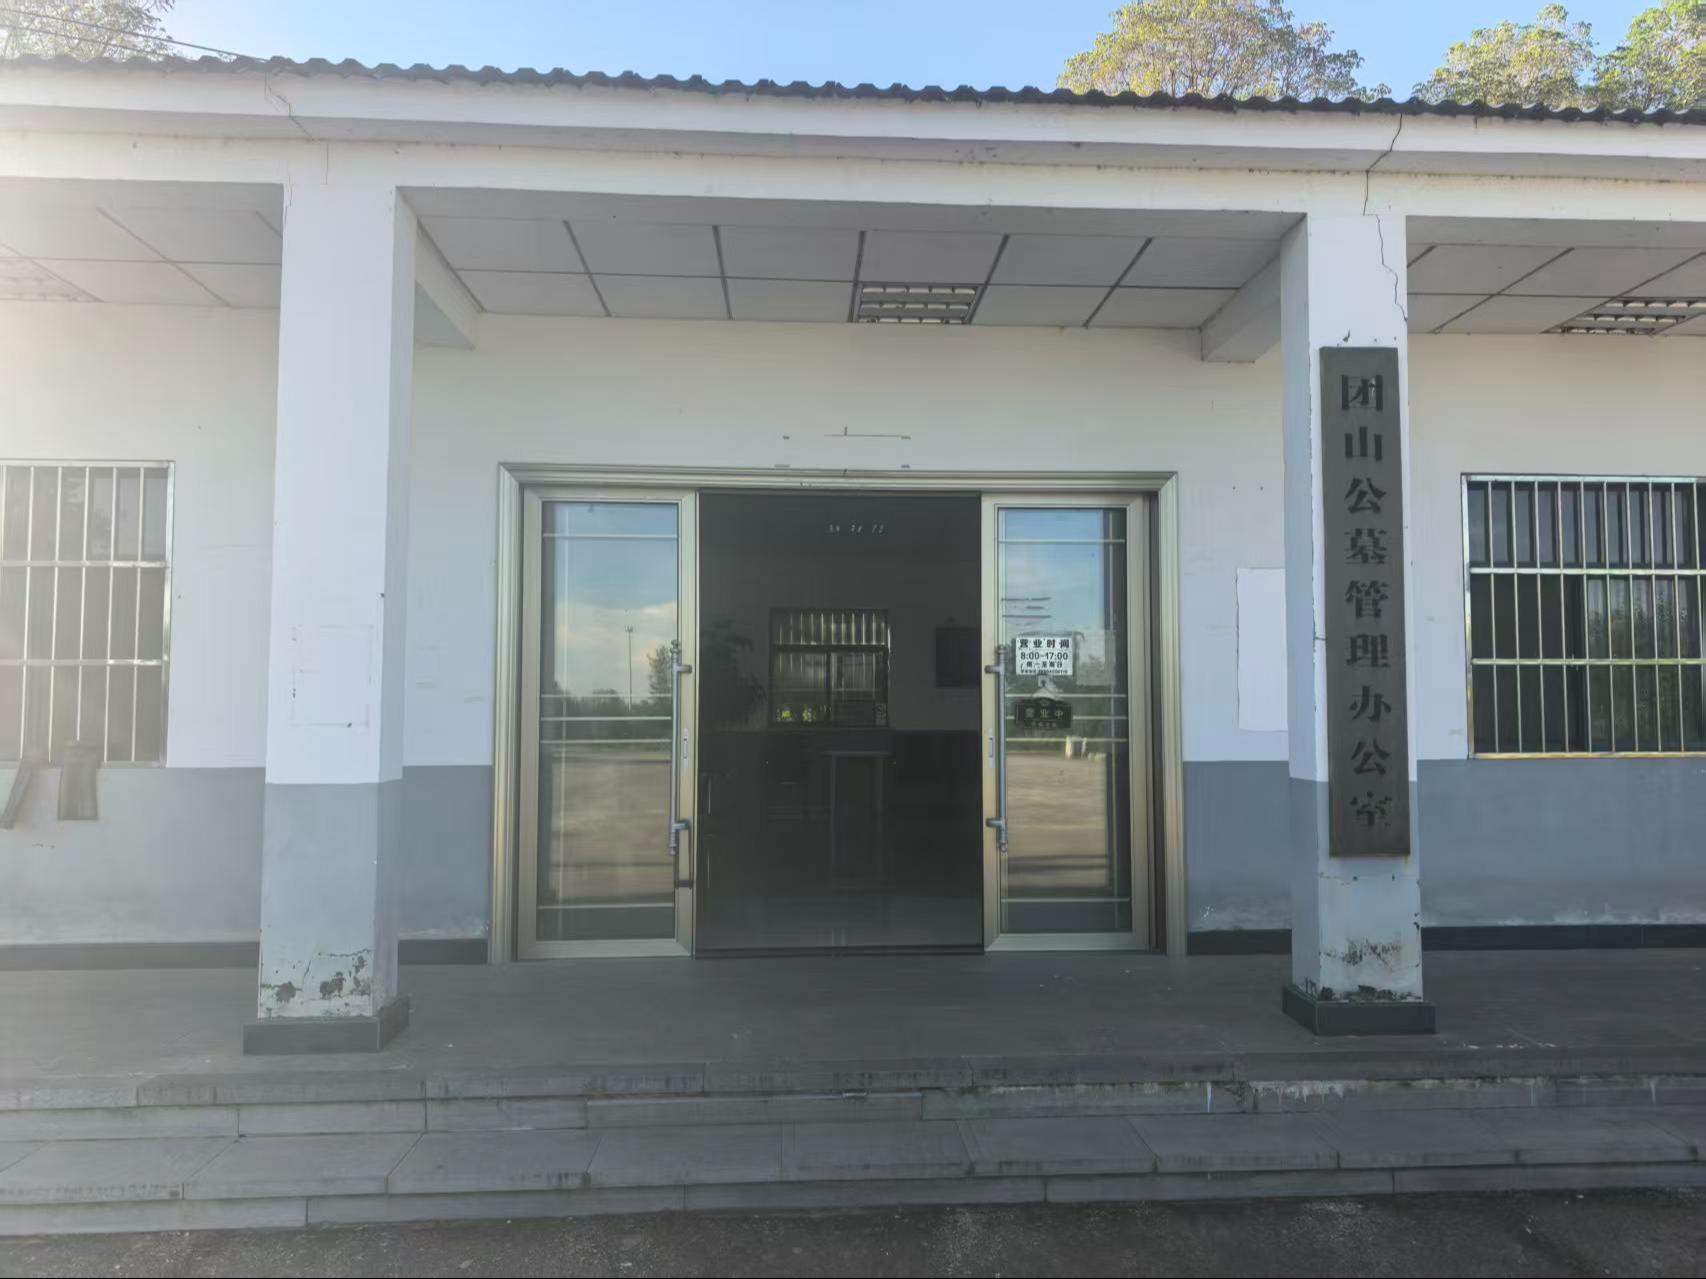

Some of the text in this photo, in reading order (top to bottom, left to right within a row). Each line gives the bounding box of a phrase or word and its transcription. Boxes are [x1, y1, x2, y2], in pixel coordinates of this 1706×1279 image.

[1019, 638, 1070, 649] 营业时间
[1341, 374, 1391, 828] 团山公墓管理办公室
